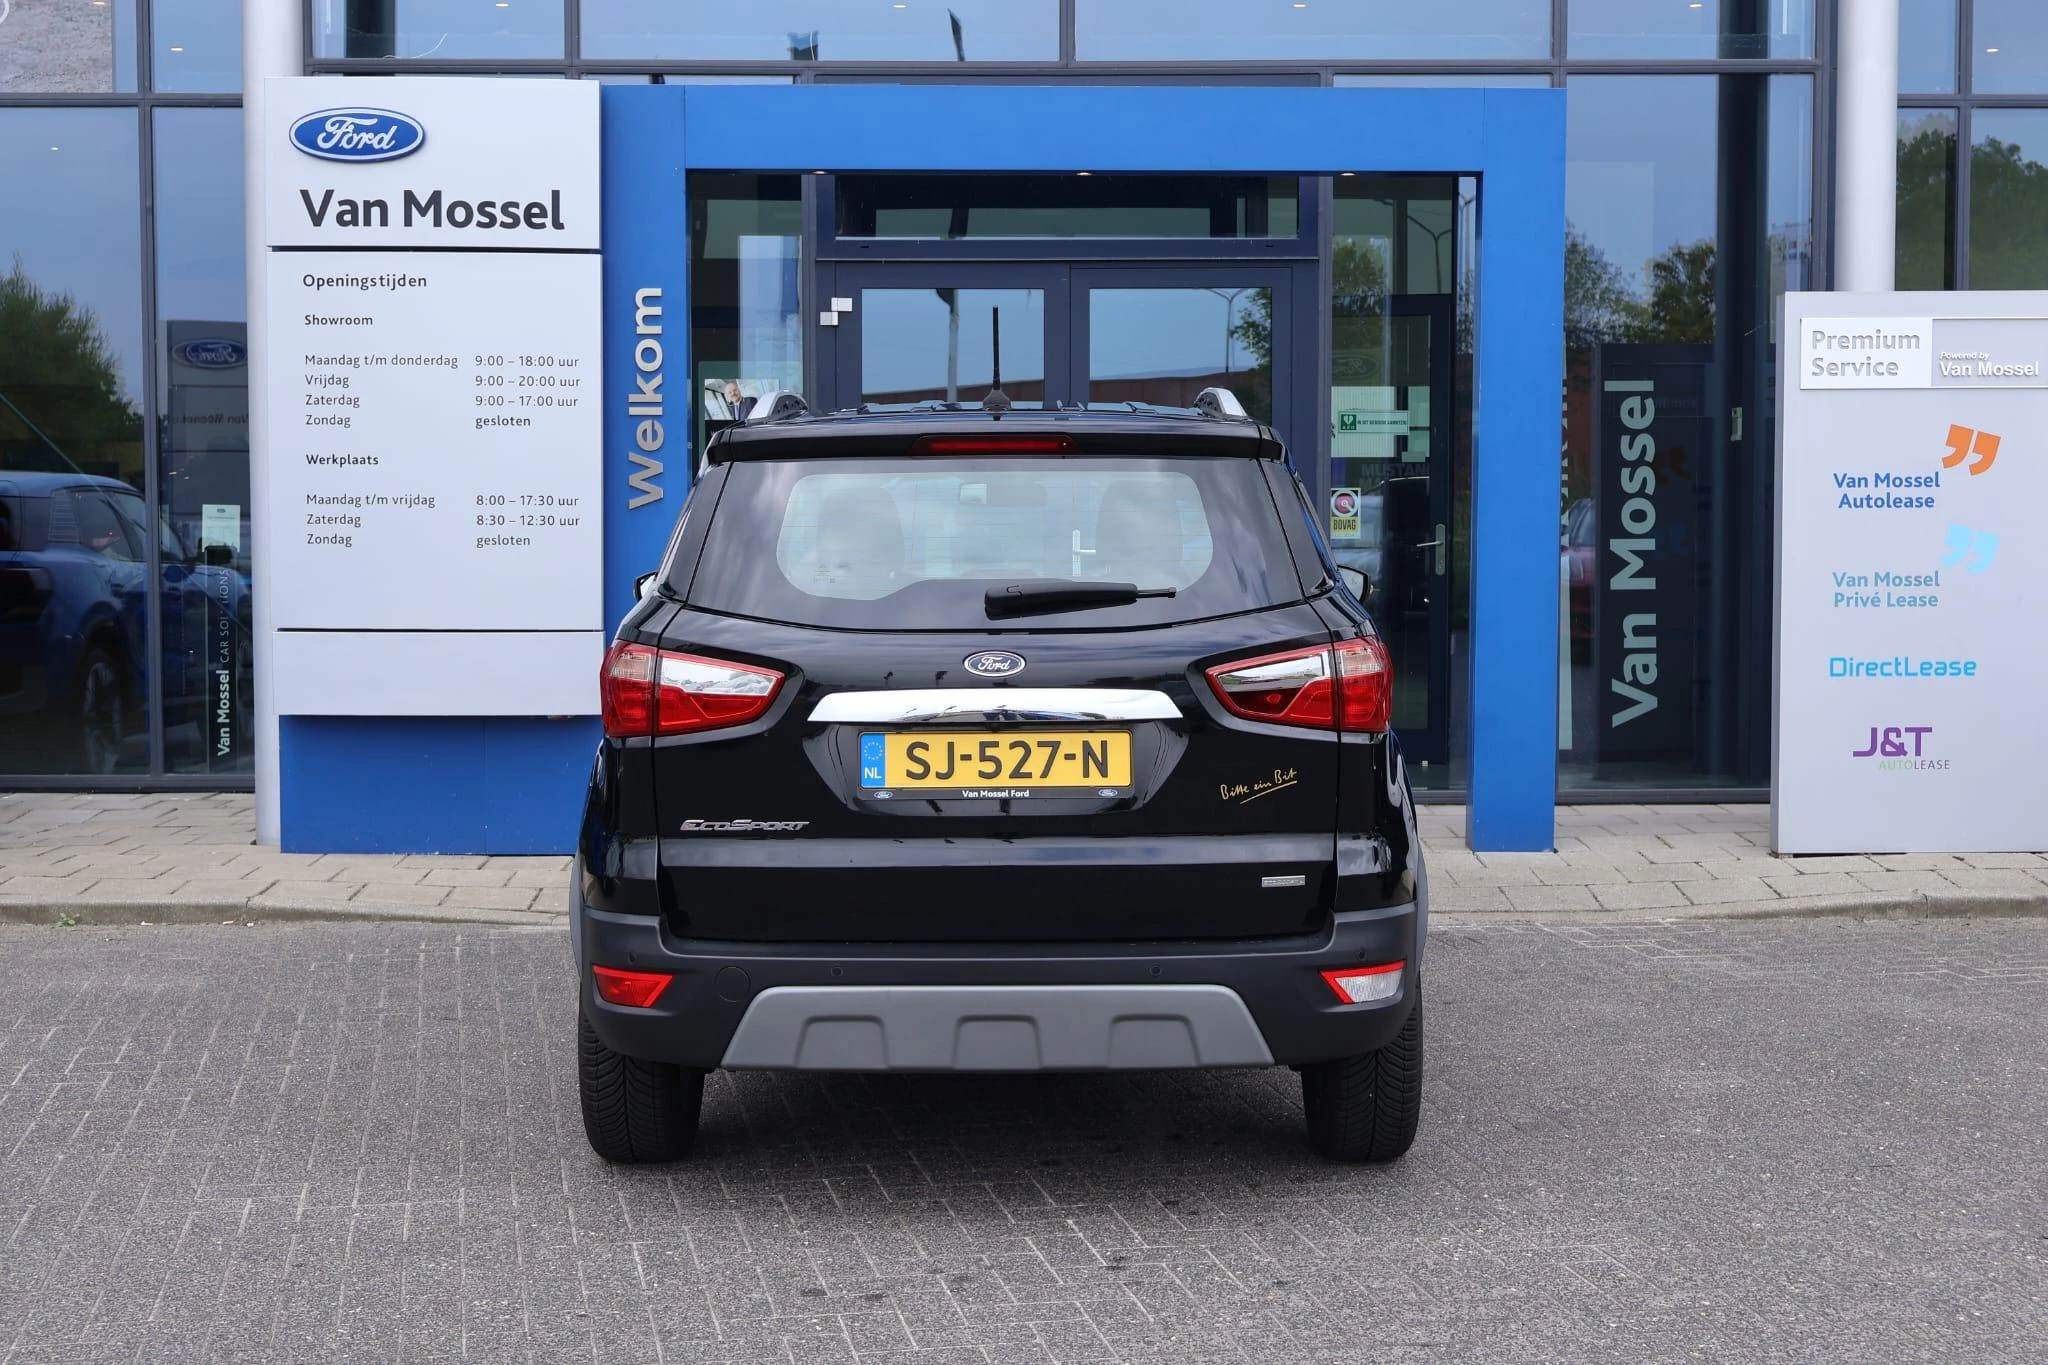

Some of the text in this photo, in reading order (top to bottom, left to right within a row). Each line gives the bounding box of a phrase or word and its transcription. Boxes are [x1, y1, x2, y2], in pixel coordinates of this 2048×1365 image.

[316, 115, 398, 151] Ford
[300, 189, 565, 230] Van Mossel
[303, 274, 426, 291] Openingstijden
[305, 314, 372, 325] Showroom
[1810, 328, 1921, 351] Premium
[306, 355, 360, 368] Maandag
[364, 355, 386, 365] t/m
[391, 354, 458, 369] donderdag
[475, 355, 503, 366] 9:00
[519, 356, 553, 366] 18:00
[1940, 352, 1990, 361] Powered by
[1811, 356, 1899, 377] Service
[1940, 361, 2040, 377] Van Mossel
[305, 374, 349, 388] Vrijdag
[476, 376, 503, 386] 9:00
[519, 376, 555, 386] 20:00
[306, 394, 359, 408] Zaterdag
[476, 396, 503, 406] 9:00
[519, 396, 553, 406] 17:00
[628, 287, 664, 510] Welkom
[306, 414, 530, 429] Zondag gesloten
[306, 454, 378, 468] Werkplaats
[1833, 472, 1940, 488] Van Mossel
[307, 494, 361, 507] Maandag
[366, 494, 388, 504] t/m
[393, 494, 435, 508] vrijdag
[477, 495, 505, 505] 8:00
[520, 496, 553, 505] 17:30
[559, 498, 579, 506] uur
[1839, 492, 1934, 508] Autolease
[307, 514, 361, 527] Zaterdag
[477, 515, 504, 525] 8:30
[520, 515, 554, 525] 12:30
[1333, 519, 1356, 531] BOVAG
[307, 534, 530, 548] Zondag gesloten
[1604, 380, 1659, 728] Van Mossel
[1832, 570, 1940, 587] Van Mossel
[1835, 592, 1938, 607] Privé Lease
[220, 636, 230, 663] CAR
[978, 656, 1011, 670] Ford
[1830, 657, 1976, 677] DirectLease
[216, 669, 230, 724] Mossel
[217, 727, 230, 756] Van
[1853, 727, 1932, 757] J&T
[905, 740, 1109, 780] SJ-527-N
[1879, 760, 1951, 771] AUTOLEASE
[864, 767, 881, 779] NL
[1220, 768, 1297, 799] Bitte ein Bit
[962, 790, 1030, 798] Van Mossel Ford
